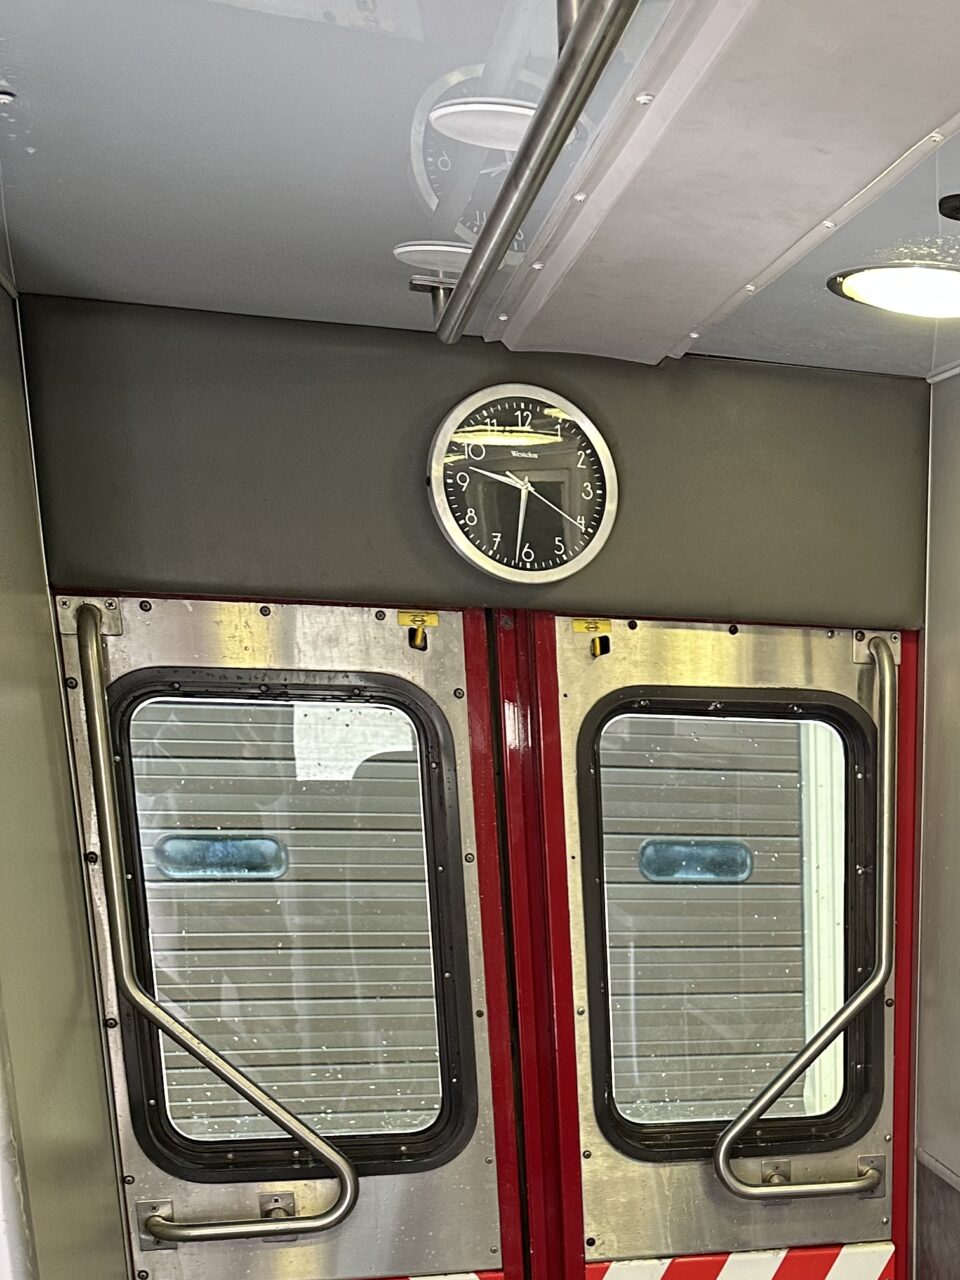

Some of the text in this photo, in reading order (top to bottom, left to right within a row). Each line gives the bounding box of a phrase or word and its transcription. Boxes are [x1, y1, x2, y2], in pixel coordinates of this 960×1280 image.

[514, 411, 532, 428] 12
[554, 424, 561, 438] 1
[463, 442, 486, 460] 10
[510, 450, 539, 459] Westclox
[577, 451, 586, 468] 2
[456, 472, 470, 491] 9
[582, 482, 594, 500] 3
[465, 508, 477, 525] 8
[576, 516, 585, 532] 4
[491, 532, 502, 550] 7
[554, 537, 564, 555] 5
[521, 543, 534, 562] 6
